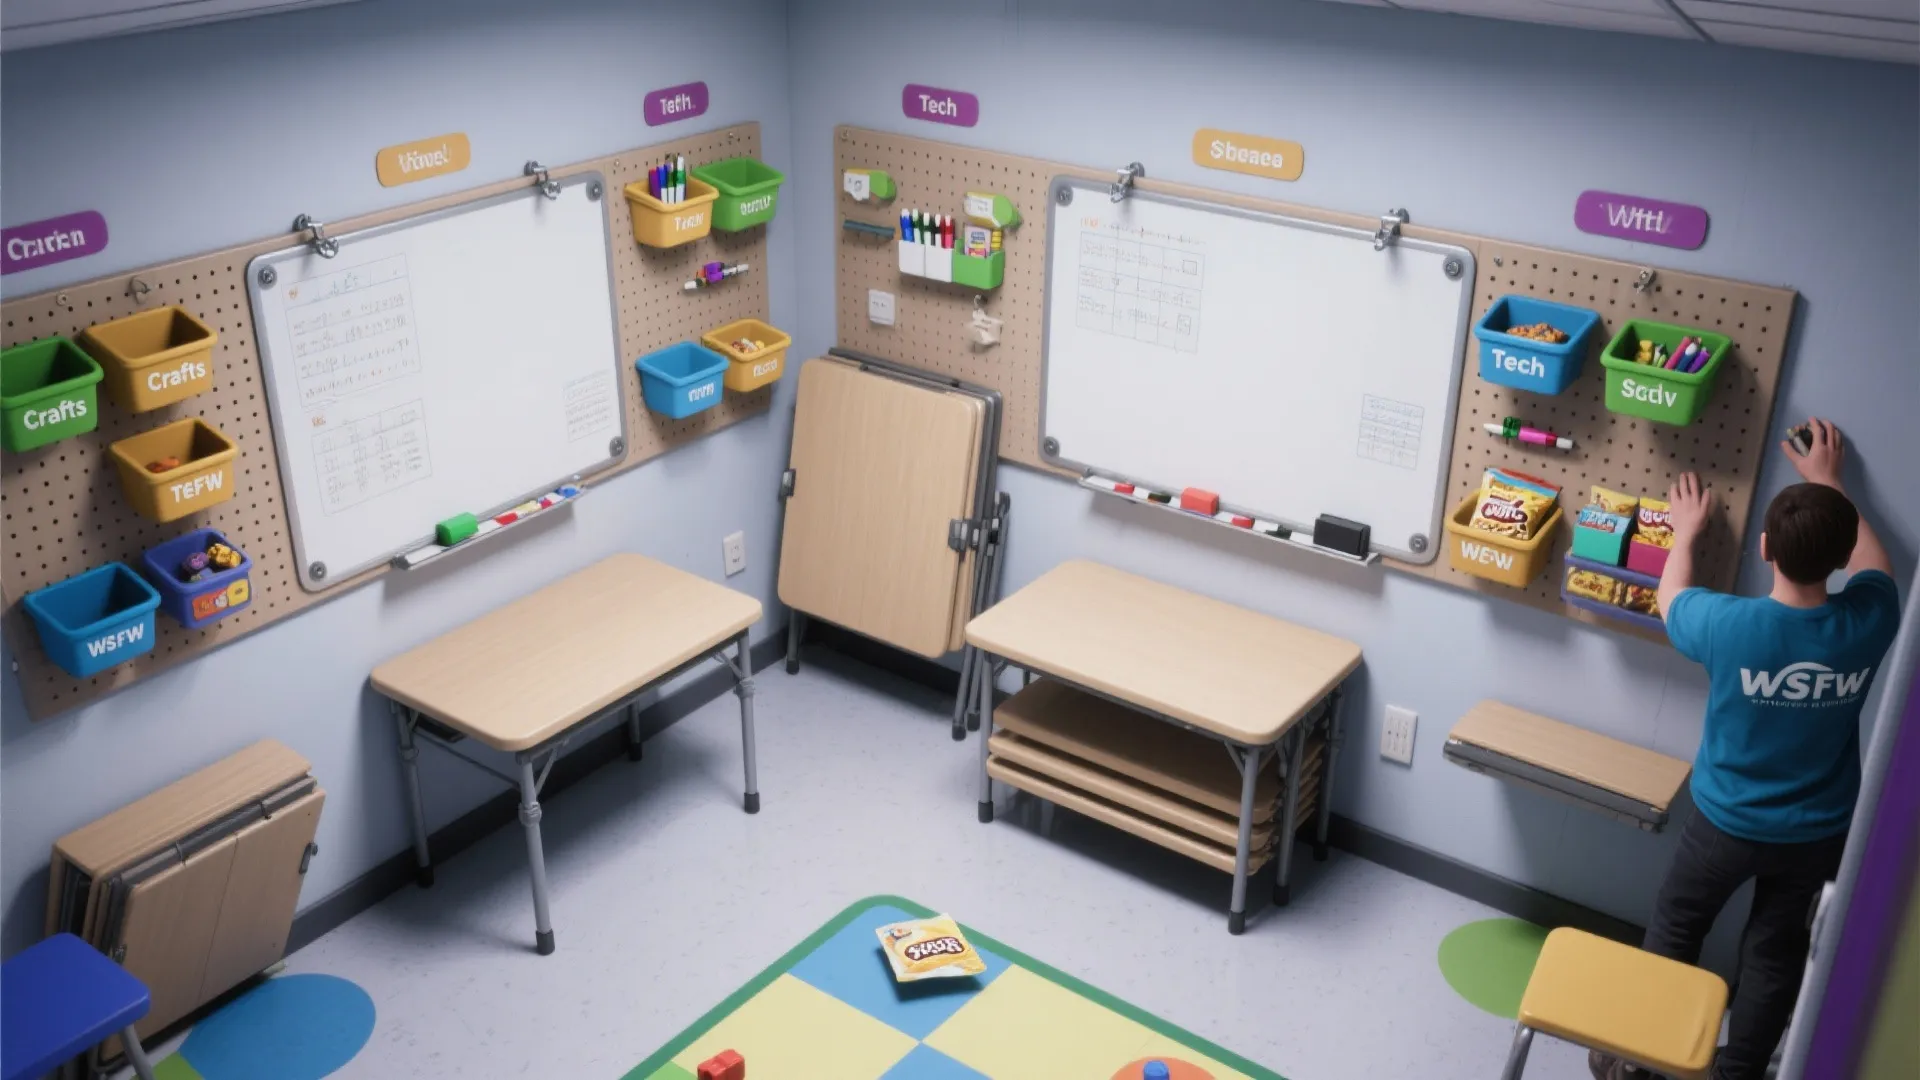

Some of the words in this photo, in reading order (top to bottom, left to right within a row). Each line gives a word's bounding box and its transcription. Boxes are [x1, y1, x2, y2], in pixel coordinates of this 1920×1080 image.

[919, 94, 957, 117] Tech
[148, 361, 206, 391] Crafts
[1492, 348, 1545, 378] Tech
[24, 399, 87, 430] Crafts
[87, 623, 144, 658] WSFW
[1740, 661, 1871, 700] WSFW
